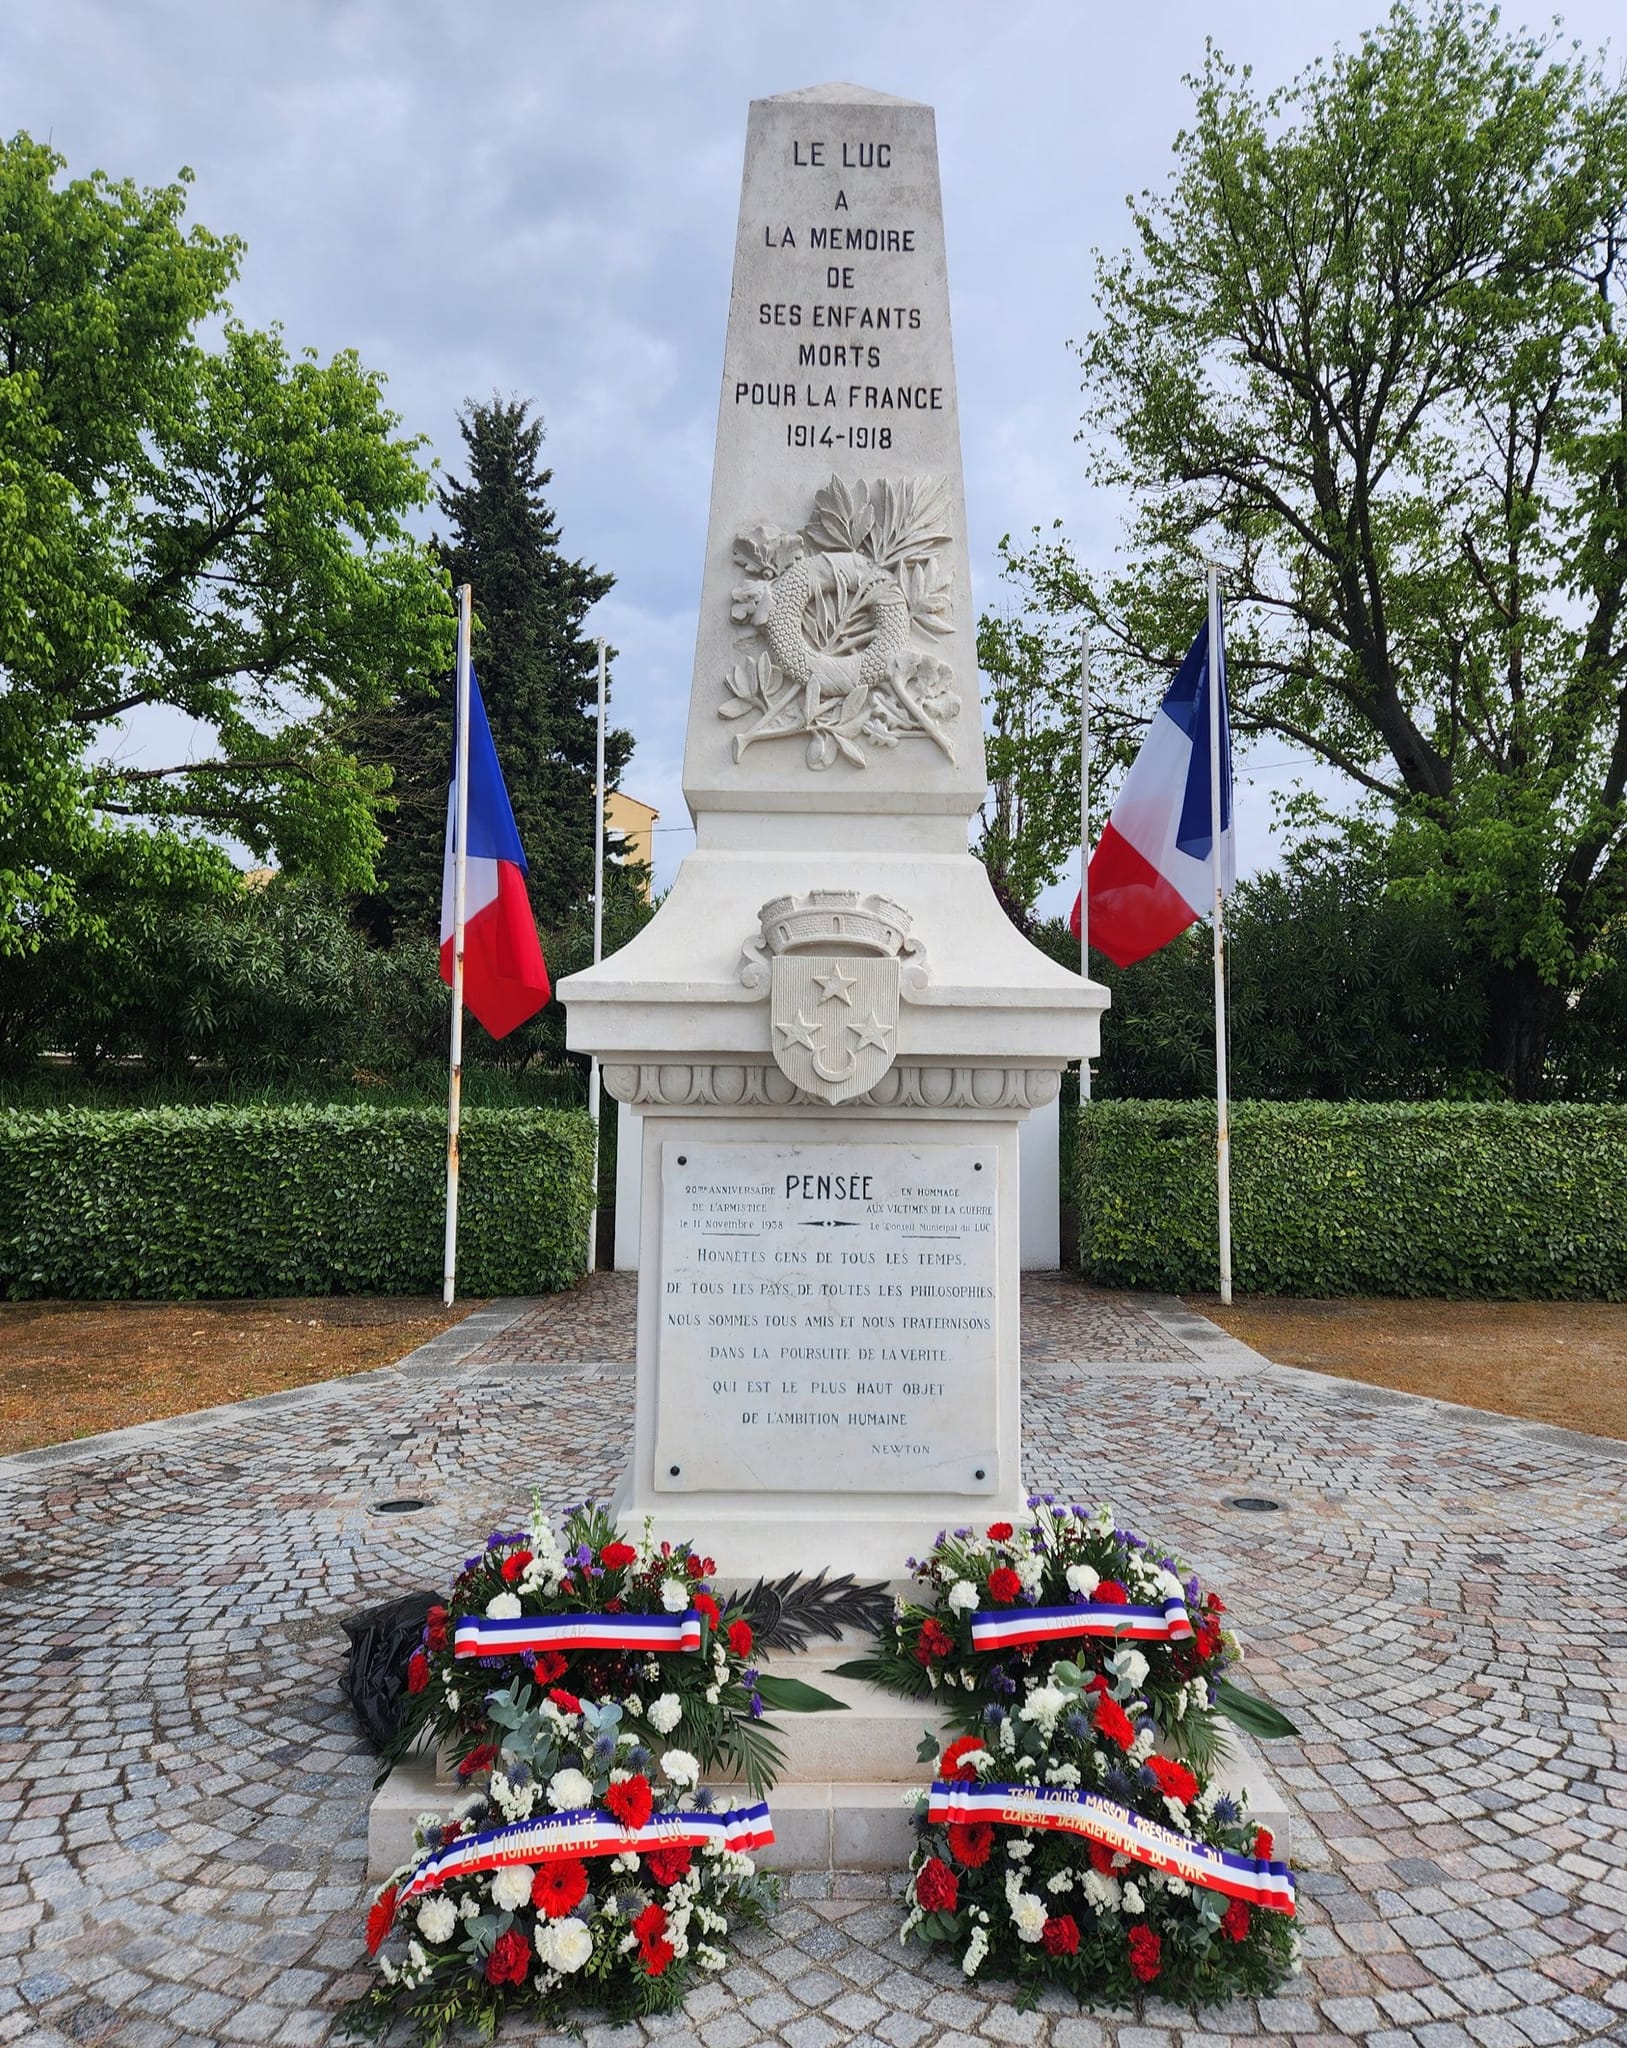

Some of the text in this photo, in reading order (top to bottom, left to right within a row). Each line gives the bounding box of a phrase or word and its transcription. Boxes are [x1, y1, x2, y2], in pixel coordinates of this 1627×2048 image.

[794, 141, 891, 168] LE LUC
[835, 191, 848, 210] A
[766, 227, 796, 247] LA
[828, 267, 854, 288] DE
[760, 305, 921, 328] SES ENFANTS
[799, 345, 880, 367] MORTS
[736, 383, 943, 409] POUR LA FRANCE
[788, 424, 892, 449] 1914-1918
[709, 1186, 775, 1195] ANNIVERSAIRE
[918, 1189, 960, 1197] HOMMAGE
[692, 1203, 766, 1213] DE L'ARMISTICE
[866, 1205, 992, 1215] AUX VICTIMES DE LA GUERRE
[706, 1220, 754, 1229] Novembre
[761, 1220, 783, 1230] 1938
[885, 1223, 915, 1231] Conseil
[919, 1223, 958, 1232] Municipal
[975, 1224, 990, 1232] LUC
[775, 1252, 807, 1263] GENS
[817, 1252, 833, 1263] DE
[841, 1252, 875, 1264] TOUS
[886, 1253, 908, 1264] LES
[667, 1282, 680, 1294] DE
[691, 1283, 723, 1294] TOUS
[732, 1283, 753, 1294] LES
[798, 1284, 813, 1295] DE
[822, 1284, 869, 1295] TOUTES
[879, 1285, 902, 1296] LES
[668, 1314, 990, 1329] NOUS SOMMES TOUS AMIS ET NOUS FRATERNISONS
[710, 1347, 744, 1359] DANS
[753, 1348, 768, 1359] LA
[781, 1348, 850, 1359] POURSUITE
[859, 1348, 875, 1359] DE
[882, 1349, 898, 1360] LA
[713, 1381, 944, 1395] QUI EST LE PLUS HAUT OBJET
[742, 1412, 907, 1425] DE L'AMBITION HUMAINE
[872, 1444, 930, 1454] NEWTON
[1008, 1788, 1037, 1801] JEAN
[1202, 1848, 1222, 1864] DU
[461, 1842, 480, 1867] LA
[654, 1818, 691, 1844] LUC
[1056, 1809, 1141, 1856] DÉPARTEMENTAL
[1149, 1850, 1167, 1866] DU
[1175, 1859, 1207, 1882] VAR
